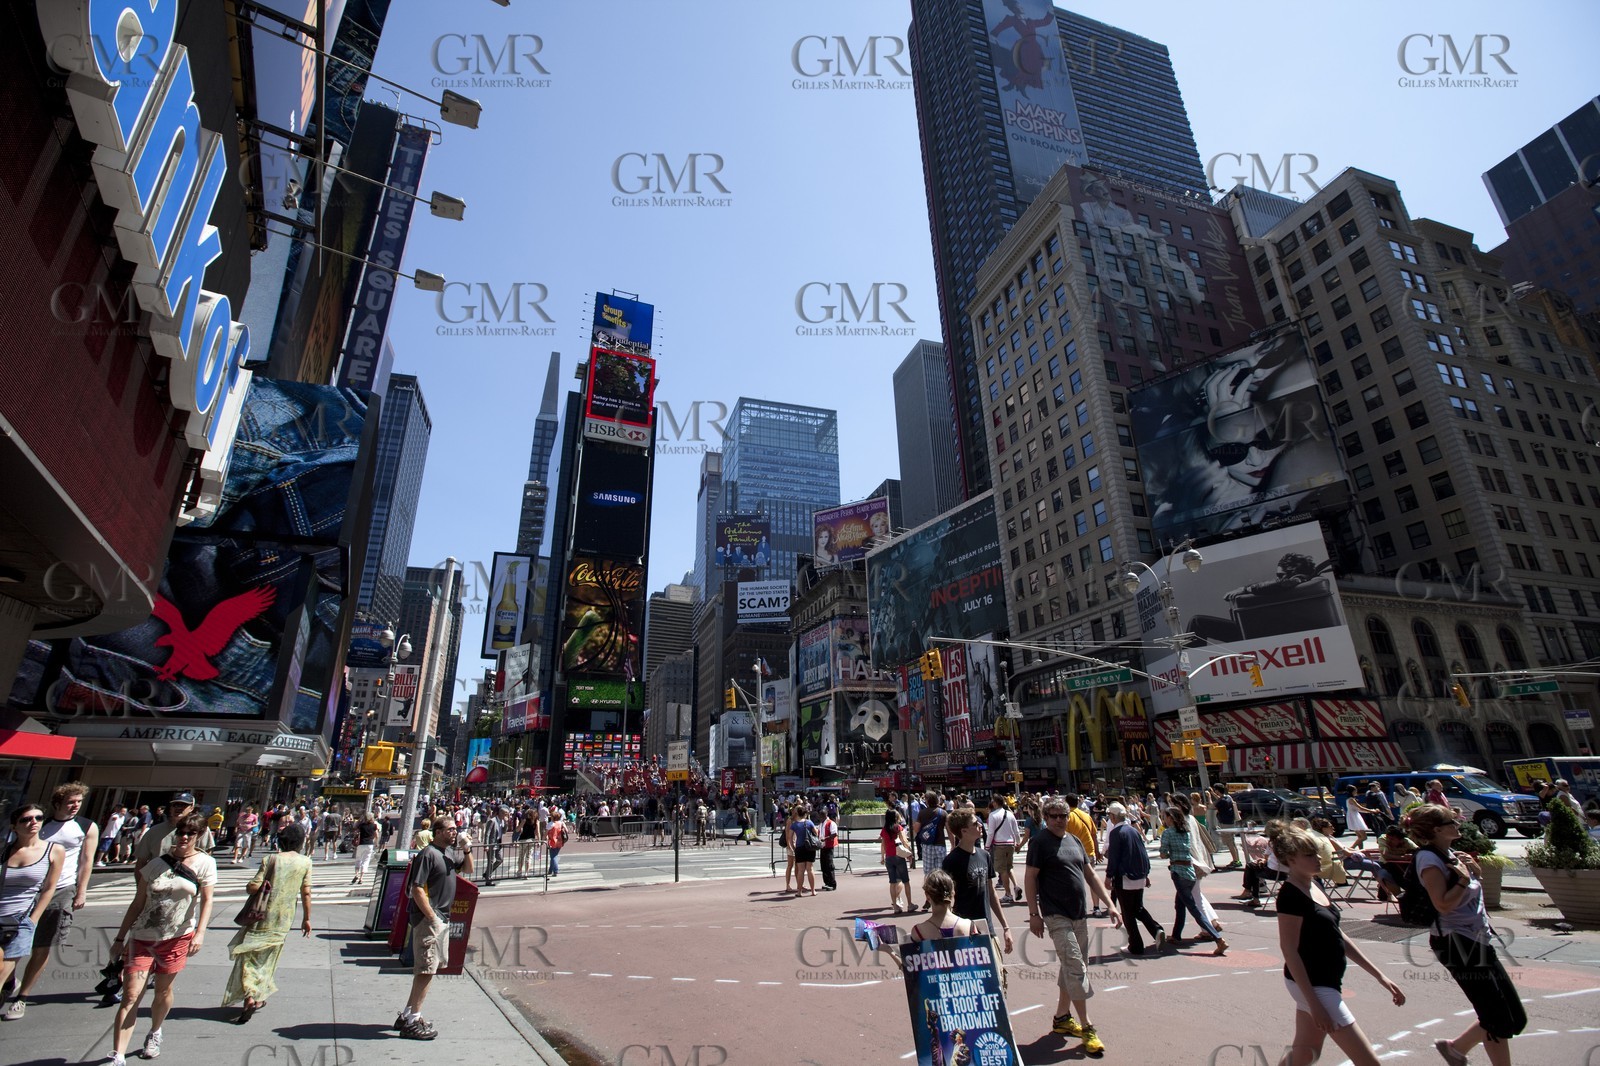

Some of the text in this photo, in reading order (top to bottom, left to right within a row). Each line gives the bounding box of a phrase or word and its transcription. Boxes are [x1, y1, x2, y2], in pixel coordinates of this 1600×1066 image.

[1015, 100, 1065, 123] MARY
[1006, 109, 1082, 145] POPPINS
[1011, 133, 1082, 159] ON BROADWAY
[1131, 181, 1178, 205] Colombian
[347, 147, 423, 382] TIMES SQUARE
[603, 304, 623, 317] Group
[601, 311, 627, 328] Benefits
[610, 335, 649, 349] Prudential
[588, 422, 626, 439] HSBC
[593, 492, 636, 504] SAMSUNG
[724, 527, 762, 535] Addams
[728, 535, 760, 546] Family
[948, 558, 958, 566] THE
[959, 550, 976, 562] DREAM
[739, 596, 789, 609] SCAM?
[962, 594, 993, 613] JULY 16
[1142, 617, 1156, 634] LIVES
[507, 649, 530, 659] INGLOT
[1209, 636, 1325, 676] maxell
[394, 674, 413, 685] BILLY
[1074, 673, 1121, 687] Broadway
[392, 686, 415, 697] ELLIOT
[507, 715, 526, 729] Travelex
[1260, 719, 1290, 729] FRIDAY'S
[1339, 715, 1366, 723] FRIDAY'S
[119, 727, 273, 745] AMERICAN EAGLE
[1211, 725, 1236, 735] FRIDAY'S
[838, 743, 892, 755] PHNTO
[533, 769, 544, 787] tkts
[724, 771, 732, 788] tkts
[905, 947, 991, 973] SPECIAL OFFER
[927, 969, 992, 984] THE NEW MUSICAL THAT'S
[938, 979, 985, 998] BLOWING
[929, 992, 1000, 1015] THE ROOF OFF
[940, 1012, 998, 1032] BROADWAY!
[974, 1034, 1007, 1049] WINNER!
[978, 1048, 1007, 1057] TONY AWARD
[980, 1055, 1008, 1066] BEST
